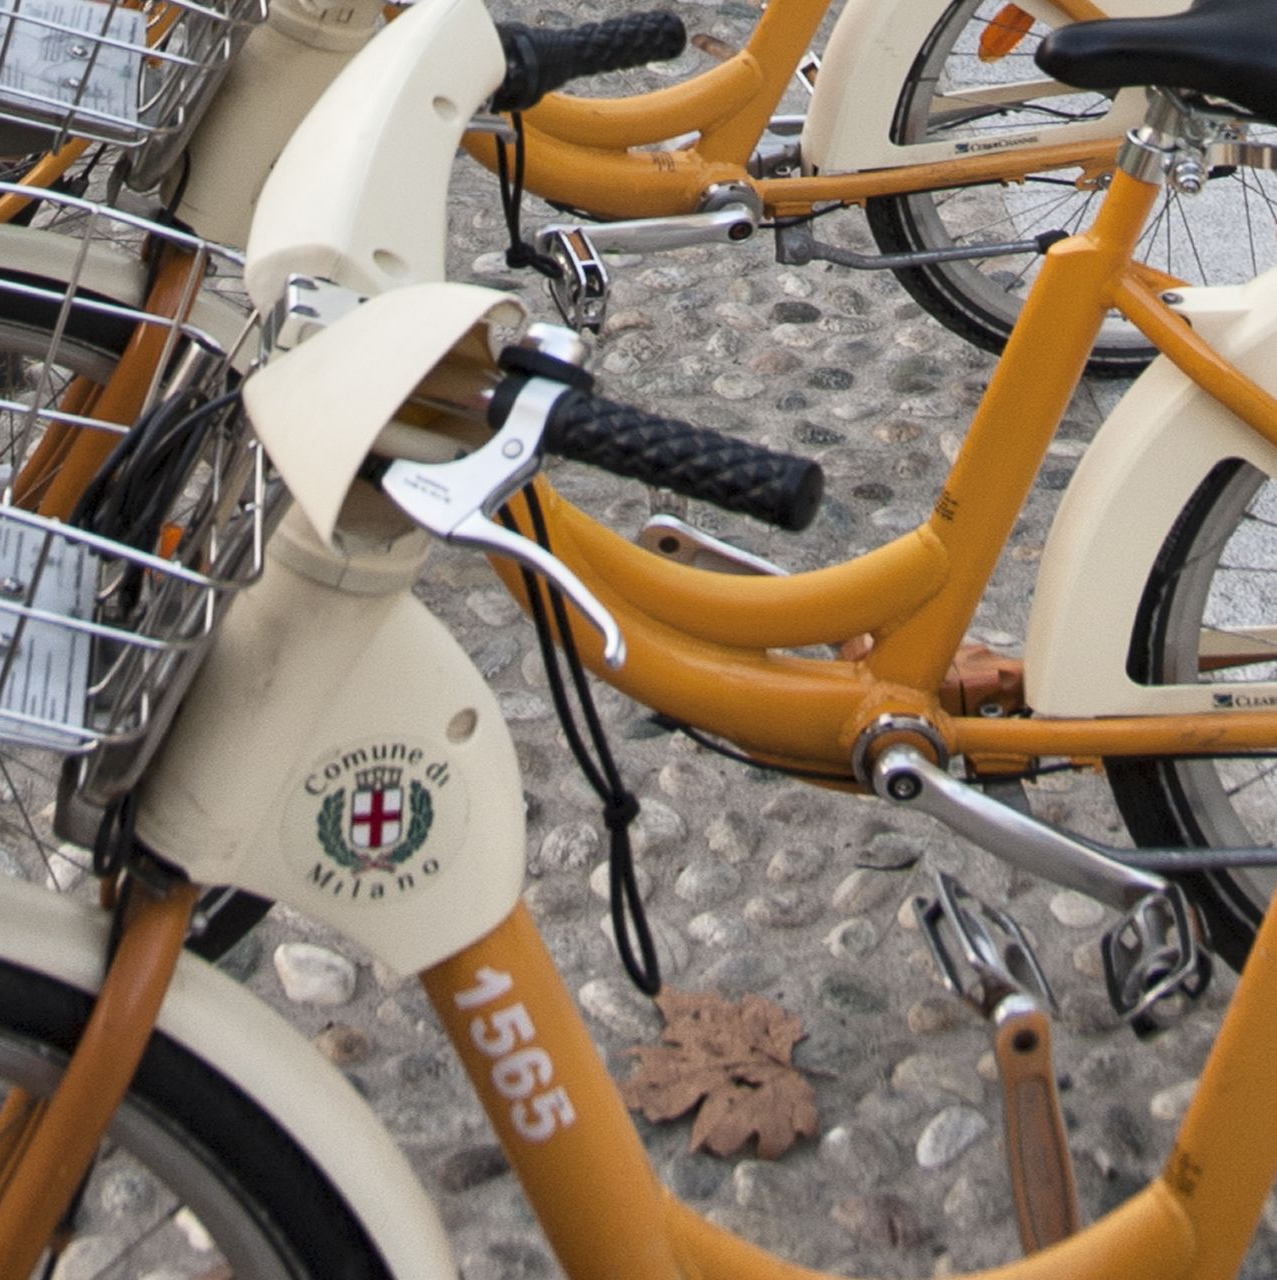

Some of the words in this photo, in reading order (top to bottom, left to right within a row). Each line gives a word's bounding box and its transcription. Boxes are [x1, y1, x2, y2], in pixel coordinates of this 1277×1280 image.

[305, 743, 422, 797] Comune
[425, 759, 450, 788] di
[306, 856, 440, 900] Milano
[454, 965, 577, 1143] 1565
